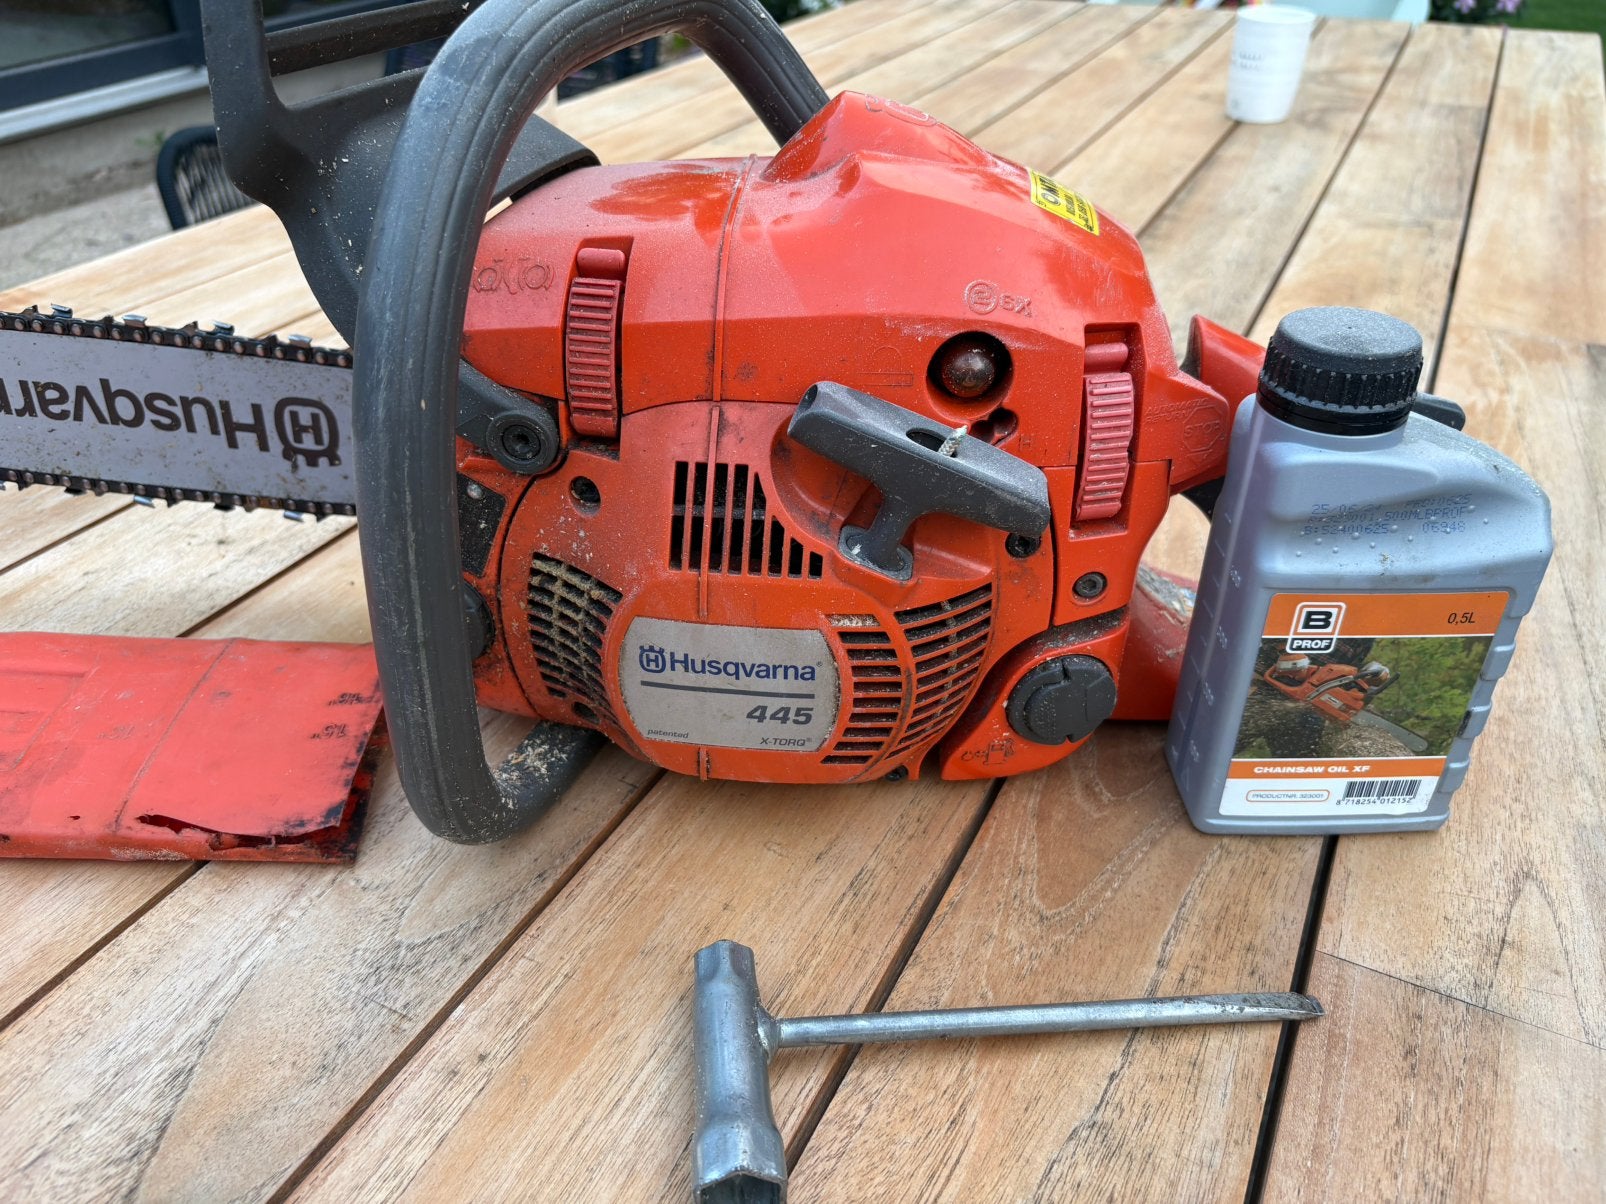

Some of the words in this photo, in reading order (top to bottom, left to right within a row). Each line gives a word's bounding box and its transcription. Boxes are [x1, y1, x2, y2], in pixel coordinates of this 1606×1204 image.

[1183, 420, 1220, 437] STOP
[1301, 610, 1333, 630] B
[1447, 612, 1476, 625] 0,5L
[1292, 639, 1332, 649] PROF
[669, 651, 816, 681] Husqvarna
[745, 705, 814, 725] 445
[647, 728, 689, 739] patented
[1253, 766, 1325, 774] CHAINSAW
[1327, 765, 1349, 773] OIL
[1352, 765, 1371, 773] XF
[1380, 797, 1413, 805] 012152
